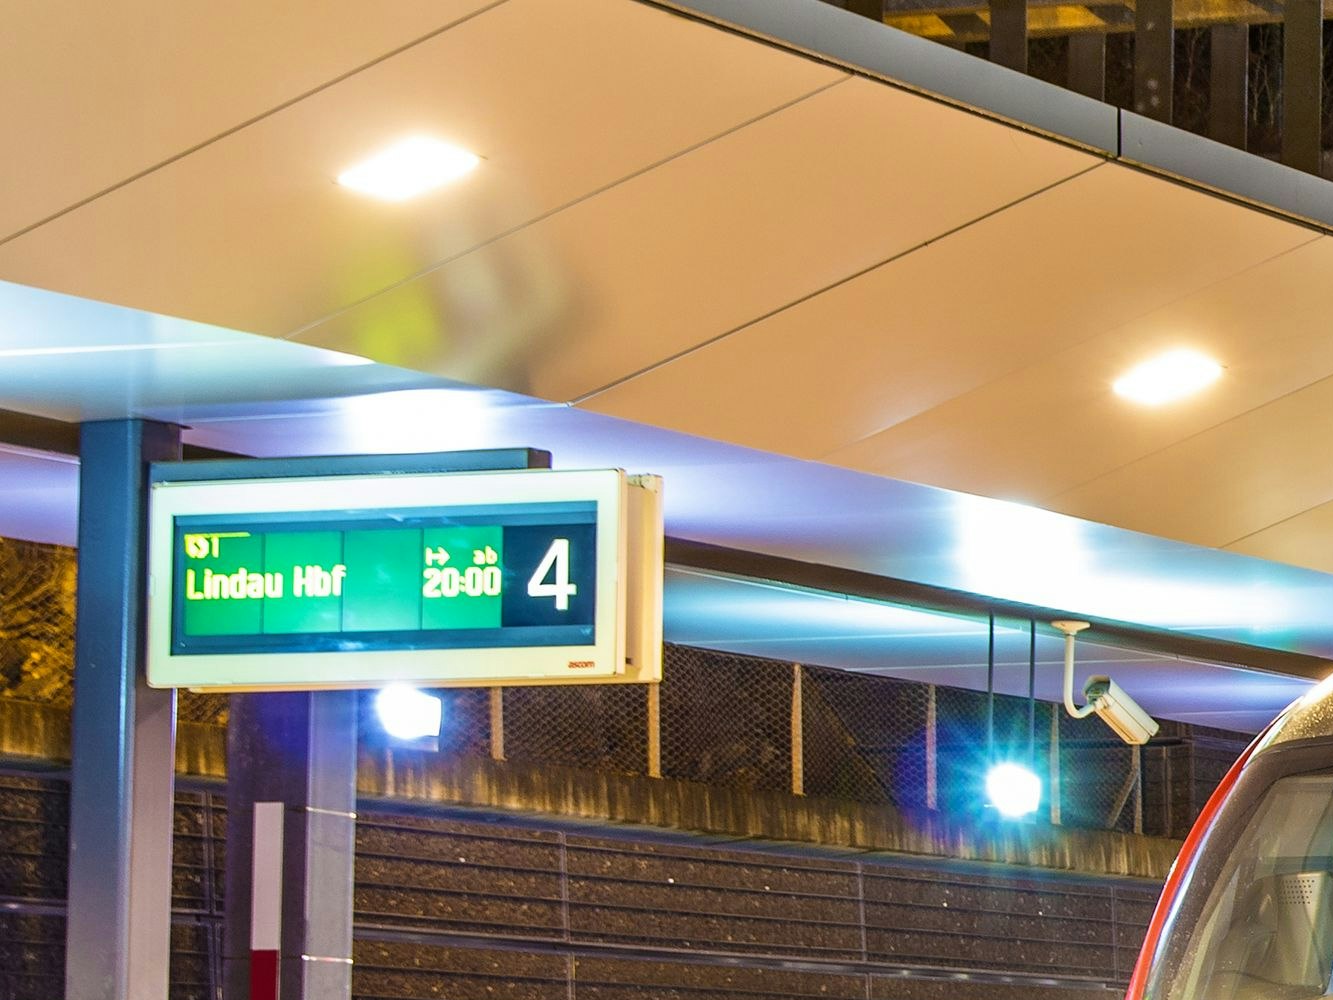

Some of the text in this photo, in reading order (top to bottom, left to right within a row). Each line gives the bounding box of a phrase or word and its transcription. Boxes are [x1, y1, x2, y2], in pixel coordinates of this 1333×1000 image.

[473, 545, 498, 566] ab
[186, 564, 347, 600] Lindau Hbf
[422, 566, 501, 598] 20:00
[527, 538, 577, 611] 4
[568, 661, 596, 669] ascom
